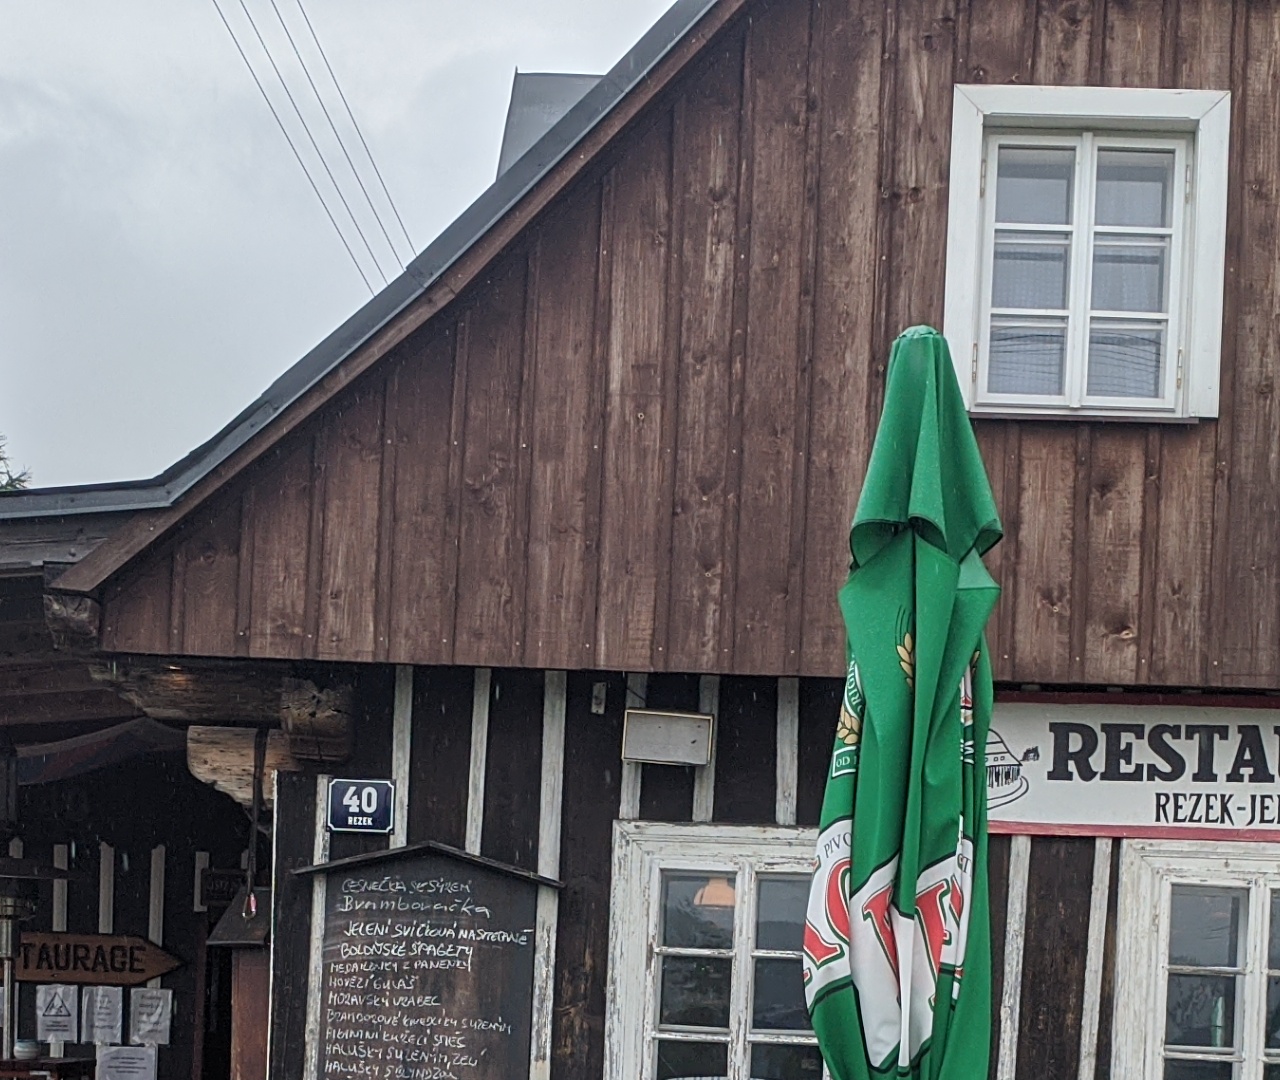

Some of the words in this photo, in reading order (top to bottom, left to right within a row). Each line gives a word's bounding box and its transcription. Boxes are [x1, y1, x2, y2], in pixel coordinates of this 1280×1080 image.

[342, 786, 378, 814] 40
[347, 816, 373, 826] REZEK
[344, 918, 391, 937] JELENÍ
[409, 940, 474, 962] ŠPAGETY
